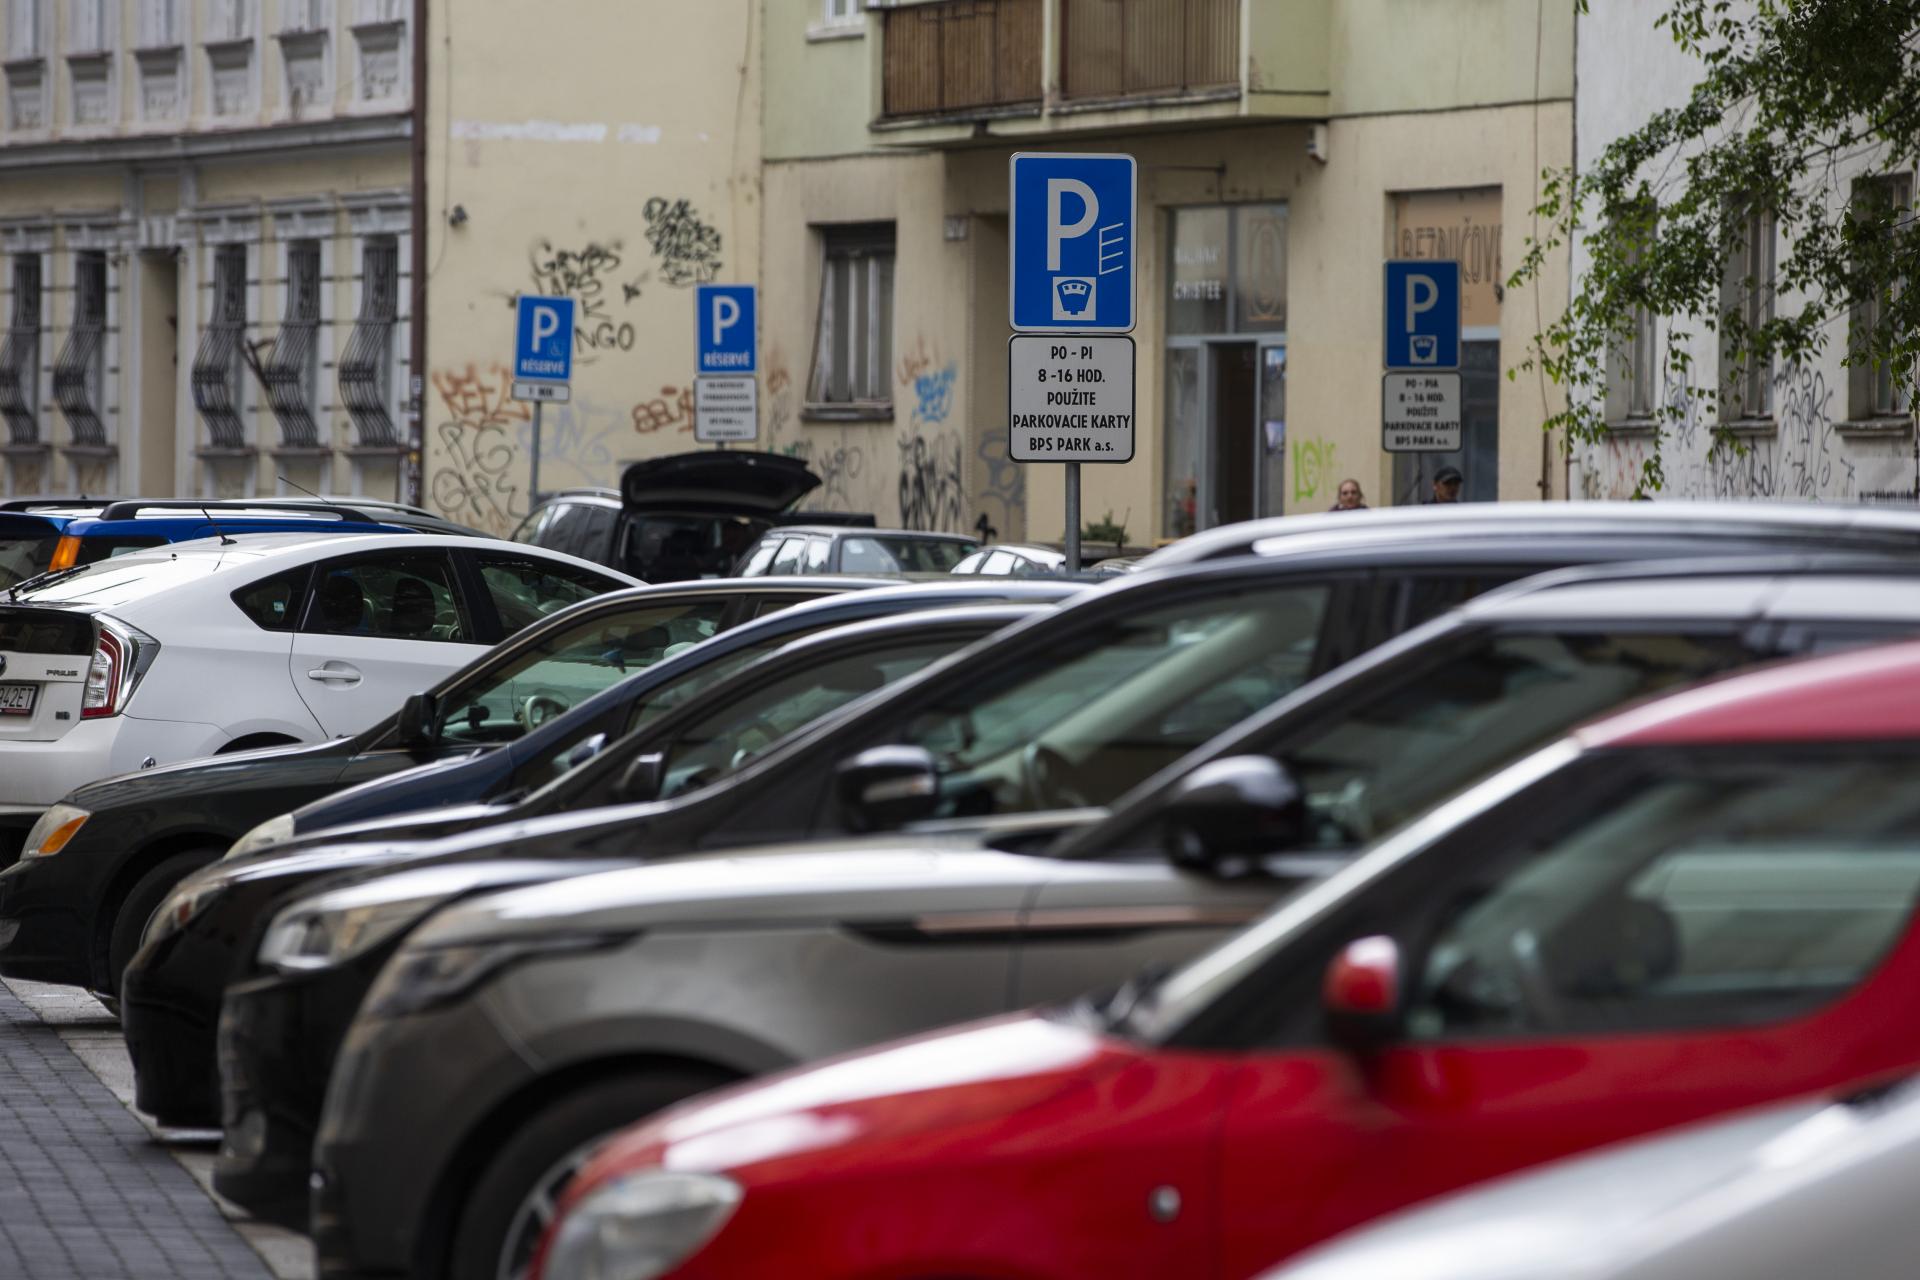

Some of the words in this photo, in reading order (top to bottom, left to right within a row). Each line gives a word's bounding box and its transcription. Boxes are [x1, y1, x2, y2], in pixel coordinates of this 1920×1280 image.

[1046, 177, 1100, 272] P
[1405, 273, 1439, 333] P
[712, 295, 741, 346] P
[531, 305, 559, 353] P
[1051, 345, 1067, 360] PO
[1081, 345, 1093, 360] PI
[1038, 368, 1047, 383] 8
[1077, 368, 1106, 383] HOD.
[1406, 378, 1417, 388] PO
[1425, 378, 1439, 388] PIA
[1047, 388, 1096, 406] POUŽITE
[1414, 393, 1424, 402] 16
[1406, 405, 1438, 417] POUŽITE
[1012, 414, 1088, 428] PARKOVACIE
[1091, 414, 1131, 428] KARTY
[1434, 421, 1459, 431] KARTY
[1029, 437, 1053, 451] BPS
[1057, 437, 1091, 451] PARK
[1094, 442, 1114, 451] a.s.
[1395, 436, 1410, 445] BPS
[1413, 436, 1434, 445] PARK
[46, 669, 79, 677] PRIUS
